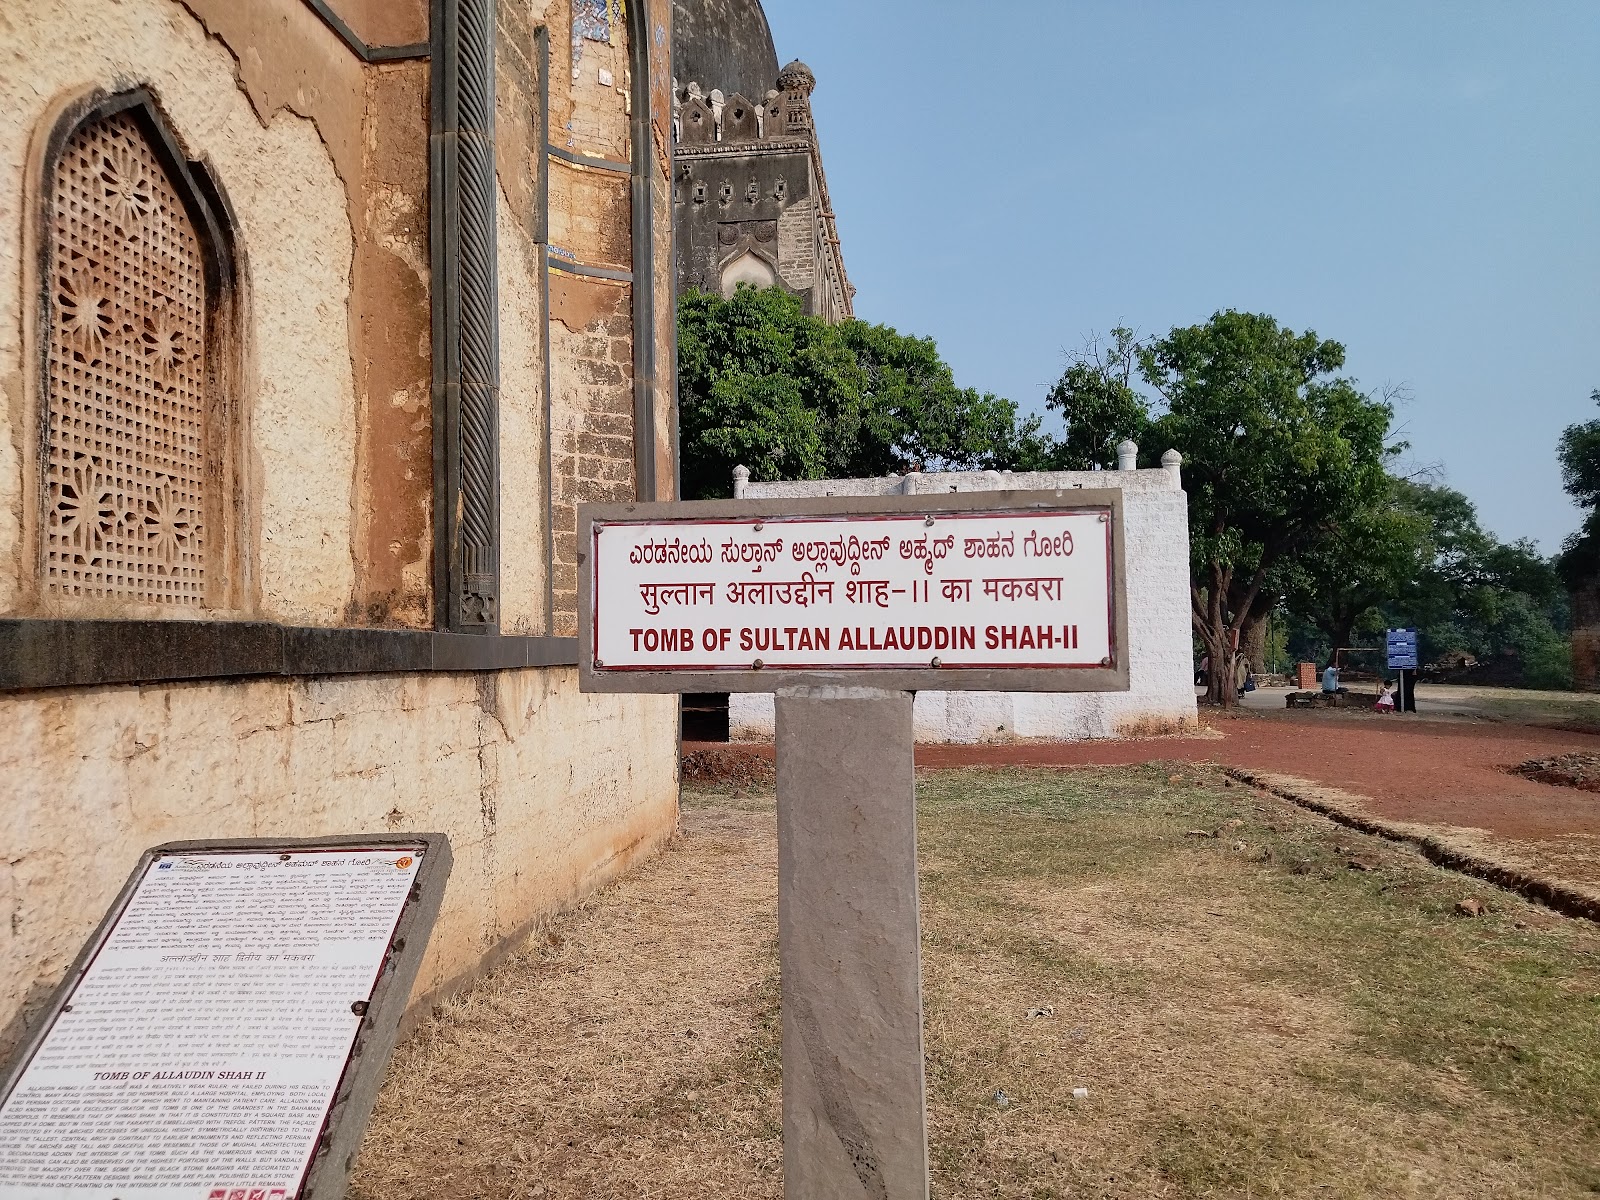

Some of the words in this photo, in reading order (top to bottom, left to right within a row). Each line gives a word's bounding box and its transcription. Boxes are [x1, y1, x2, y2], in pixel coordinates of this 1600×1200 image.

[630, 537, 713, 564] ಎರಡನೇಯ
[721, 537, 783, 572] ಸುಲ್ತಾನ್
[792, 534, 890, 575] ಅಲ್ಲಾವುದ್ದೀನ್
[964, 531, 1015, 558] ಶಾಹನ
[1024, 530, 1074, 557] ಗೋರಿ
[640, 583, 716, 615] सुल्तान
[726, 572, 834, 608] अलाउद्दीन
[941, 580, 972, 602] का
[982, 578, 1064, 602] मकबरा
[629, 628, 694, 652] TOMB
[702, 628, 731, 651] OF
[739, 627, 830, 651] SULTAN
[839, 626, 976, 650] ALLAUDDIN
[985, 625, 1078, 649] SHAH-II
[152, 1071, 215, 1080] ALLAUDIN
